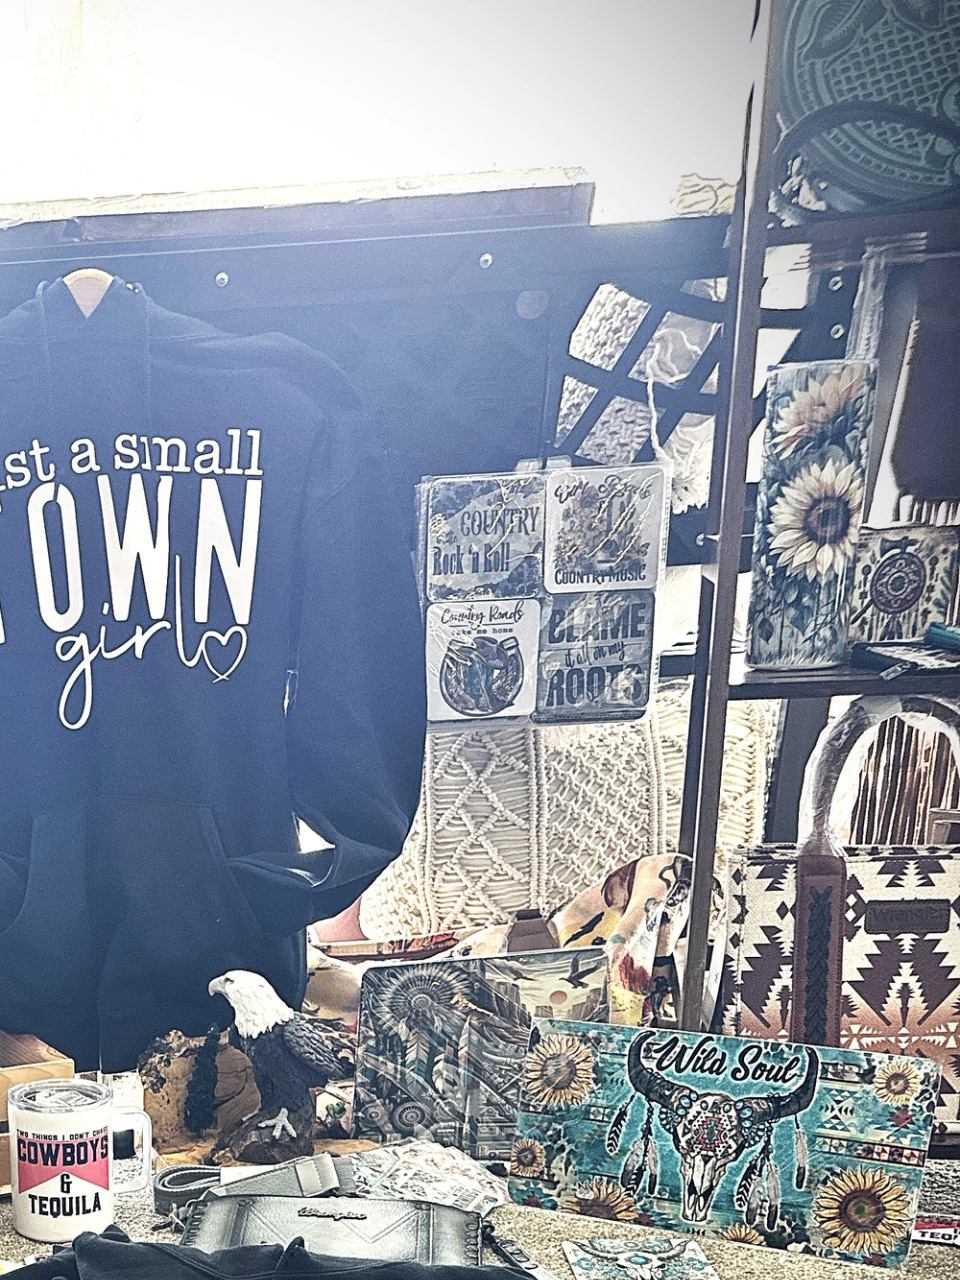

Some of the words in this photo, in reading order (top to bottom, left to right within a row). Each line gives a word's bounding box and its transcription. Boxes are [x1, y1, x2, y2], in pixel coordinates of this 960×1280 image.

[70, 437, 101, 474] a
[113, 428, 264, 476] small
[460, 506, 540, 538] COUNTRY
[432, 545, 464, 576] Rock
[54, 554, 203, 730] girl
[492, 627, 514, 635] home
[653, 1036, 728, 1076] Wild
[731, 1044, 800, 1083] Soul
[16, 1134, 109, 1167] COWBOYS
[32, 1132, 58, 1141] THINGS
[60, 1173, 73, 1194] &
[28, 1191, 102, 1219] TEQUILA
